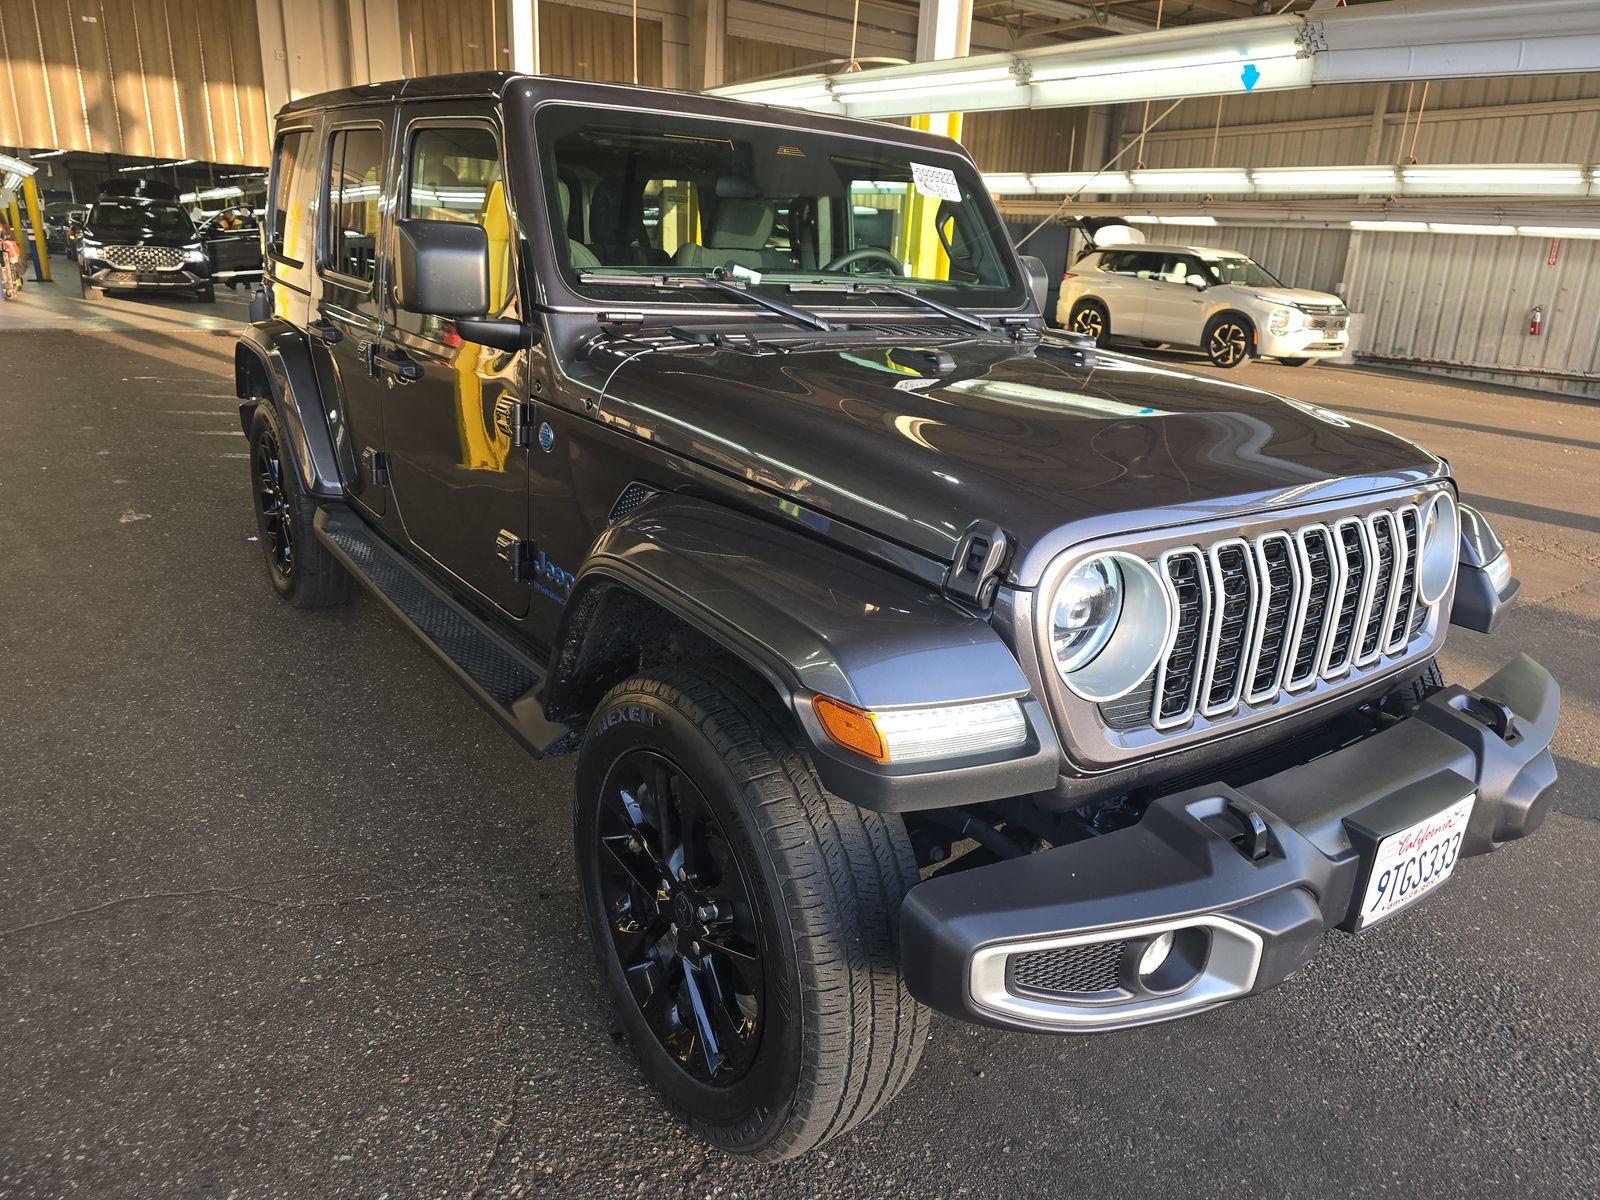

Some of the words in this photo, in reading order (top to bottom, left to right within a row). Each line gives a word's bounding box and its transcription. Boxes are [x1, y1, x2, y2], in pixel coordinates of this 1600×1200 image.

[534, 550, 576, 595] Jeep
[595, 706, 654, 736] NEXEN
[1398, 817, 1456, 856] California
[1370, 831, 1461, 913] 9TGS333
